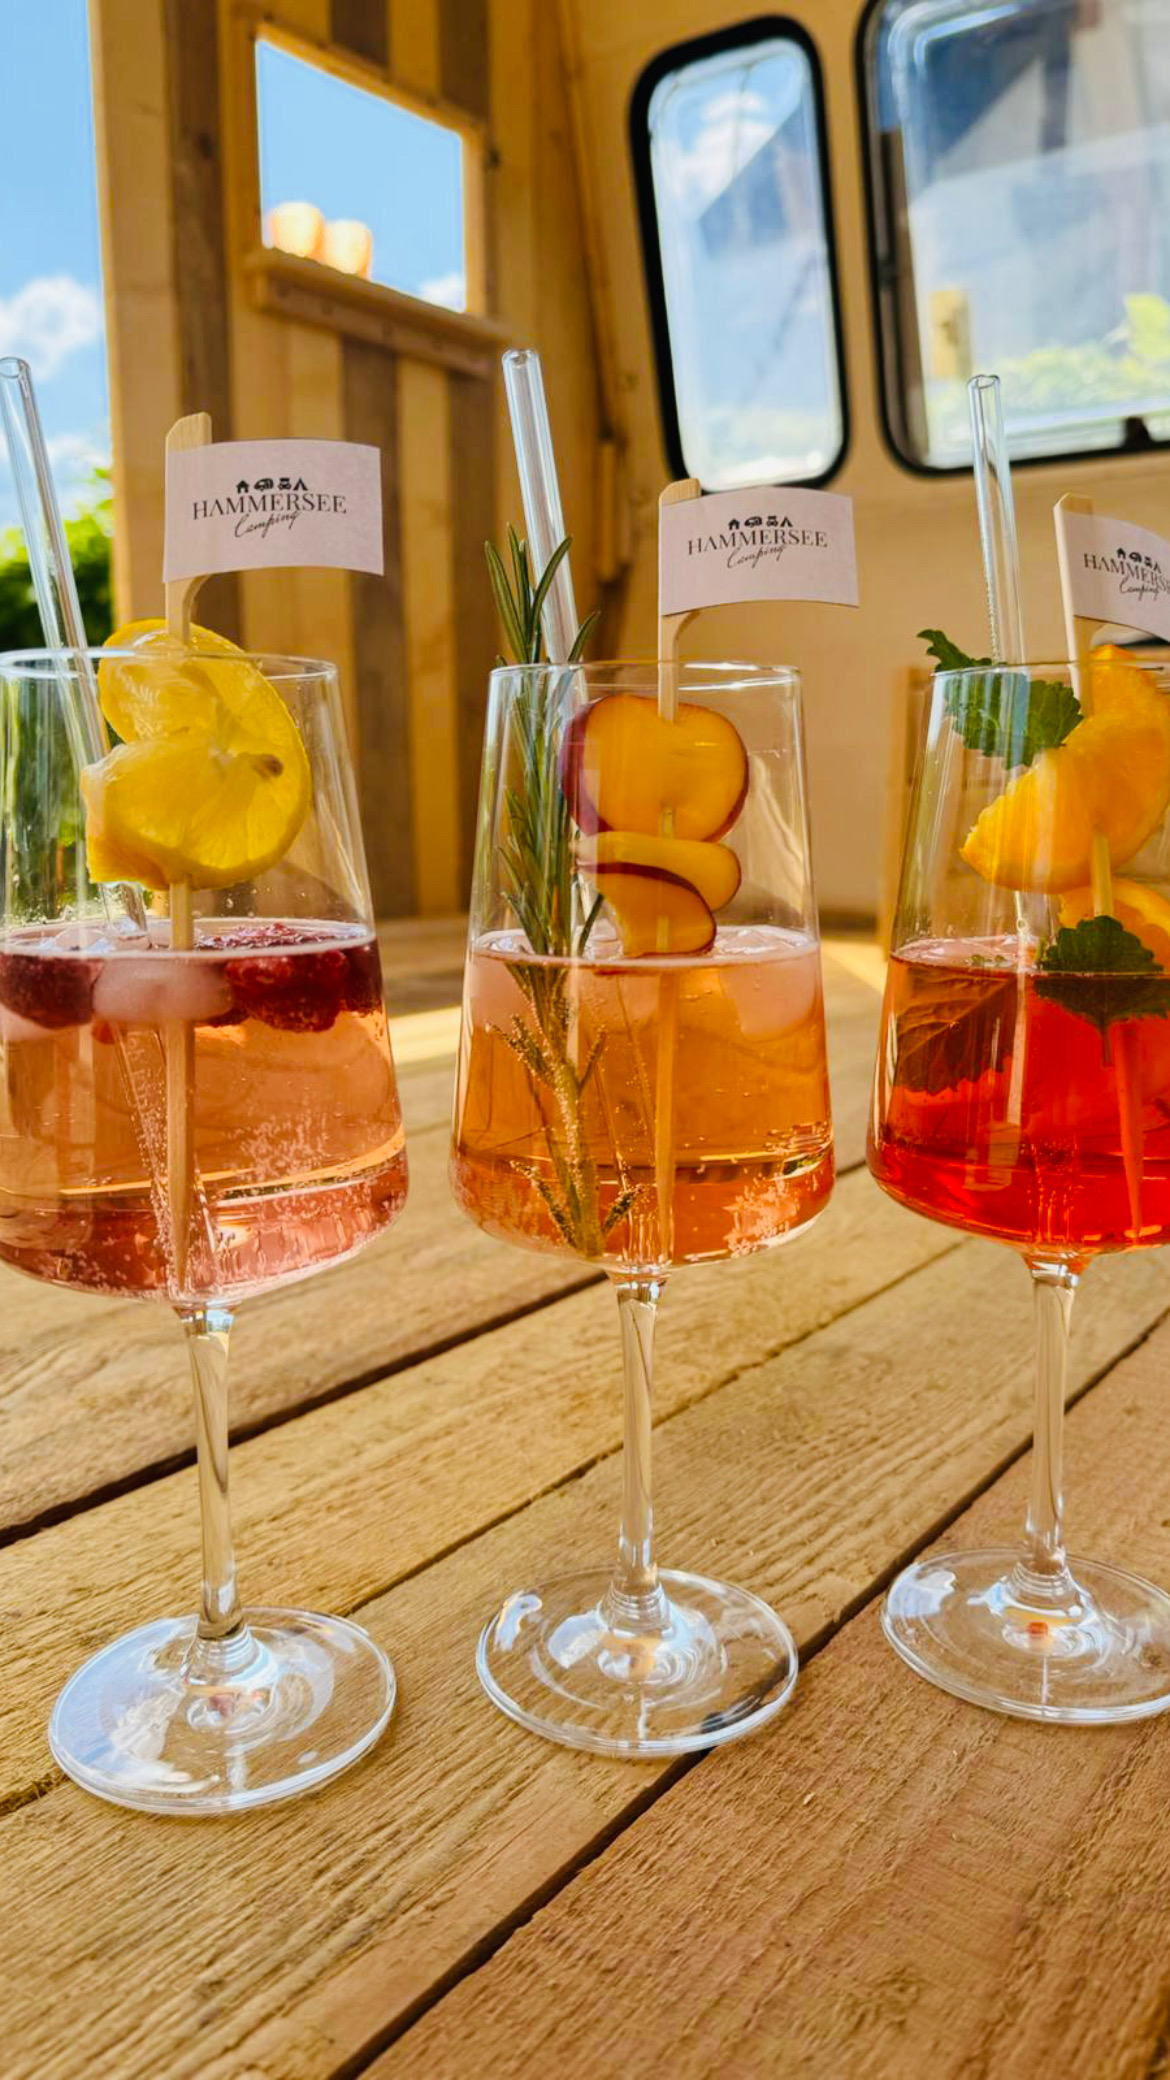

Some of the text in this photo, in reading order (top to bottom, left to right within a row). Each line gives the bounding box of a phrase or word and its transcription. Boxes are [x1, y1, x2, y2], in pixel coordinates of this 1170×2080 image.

[193, 493, 347, 520] HAMMERSEE
[234, 510, 301, 538] Camping
[688, 529, 828, 555] HAMMERSEE
[727, 545, 787, 569] Camping
